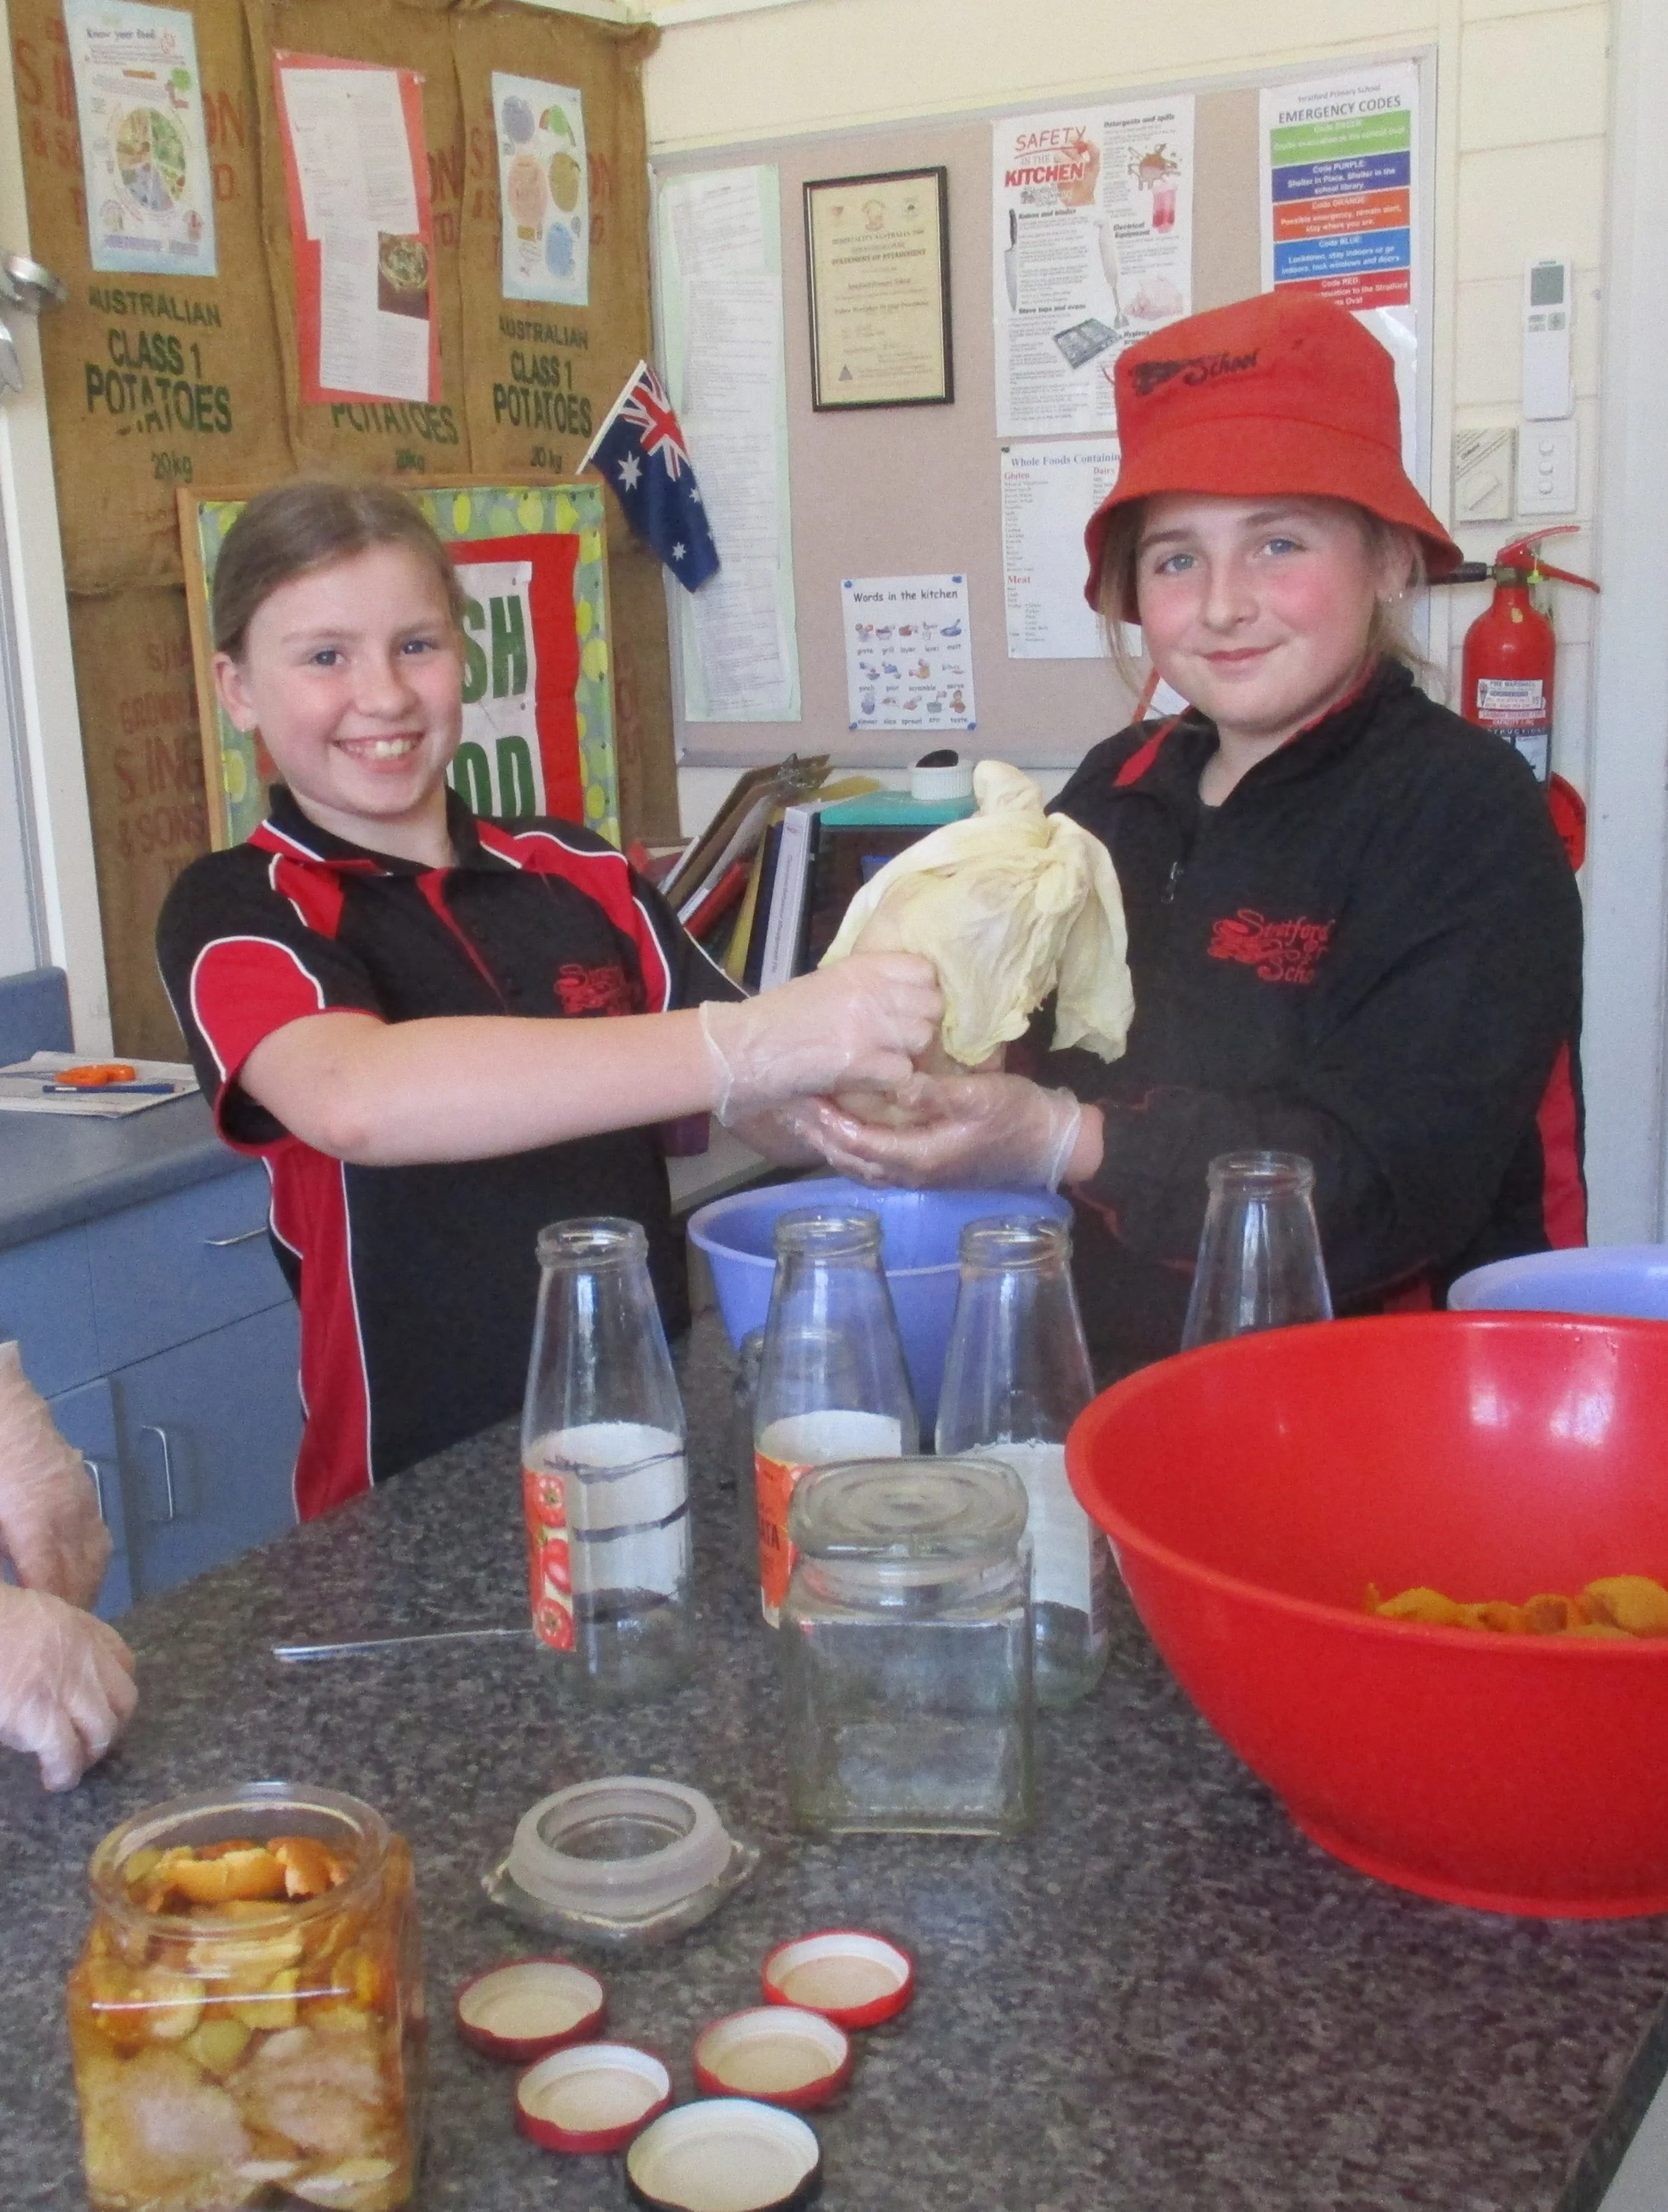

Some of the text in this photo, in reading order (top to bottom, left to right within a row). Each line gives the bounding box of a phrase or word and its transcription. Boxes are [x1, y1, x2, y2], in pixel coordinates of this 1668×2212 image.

[1298, 84, 1381, 102] Stratford Primary School
[1278, 95, 1401, 124] EMERGENCY CODES
[1014, 125, 1086, 152] SAFETY
[1004, 163, 1085, 188] KITCHEN
[1318, 238, 1338, 248] Code
[1321, 278, 1340, 288] Code
[89, 285, 222, 328] AUSTRALIAN
[498, 314, 588, 350] AUSTRALIAN
[107, 328, 201, 379] CLASS 1
[510, 350, 572, 394] CLASS 1
[85, 362, 233, 434] POTATOES
[492, 382, 593, 438] POTATOES
[1011, 456, 1039, 467] Whole
[1042, 455, 1070, 466] Foods
[1093, 466, 1116, 475] Dairy
[1004, 472, 1030, 480] Gluten
[1007, 575, 1031, 585] Meat
[854, 589, 958, 603] Words in the kitchen
